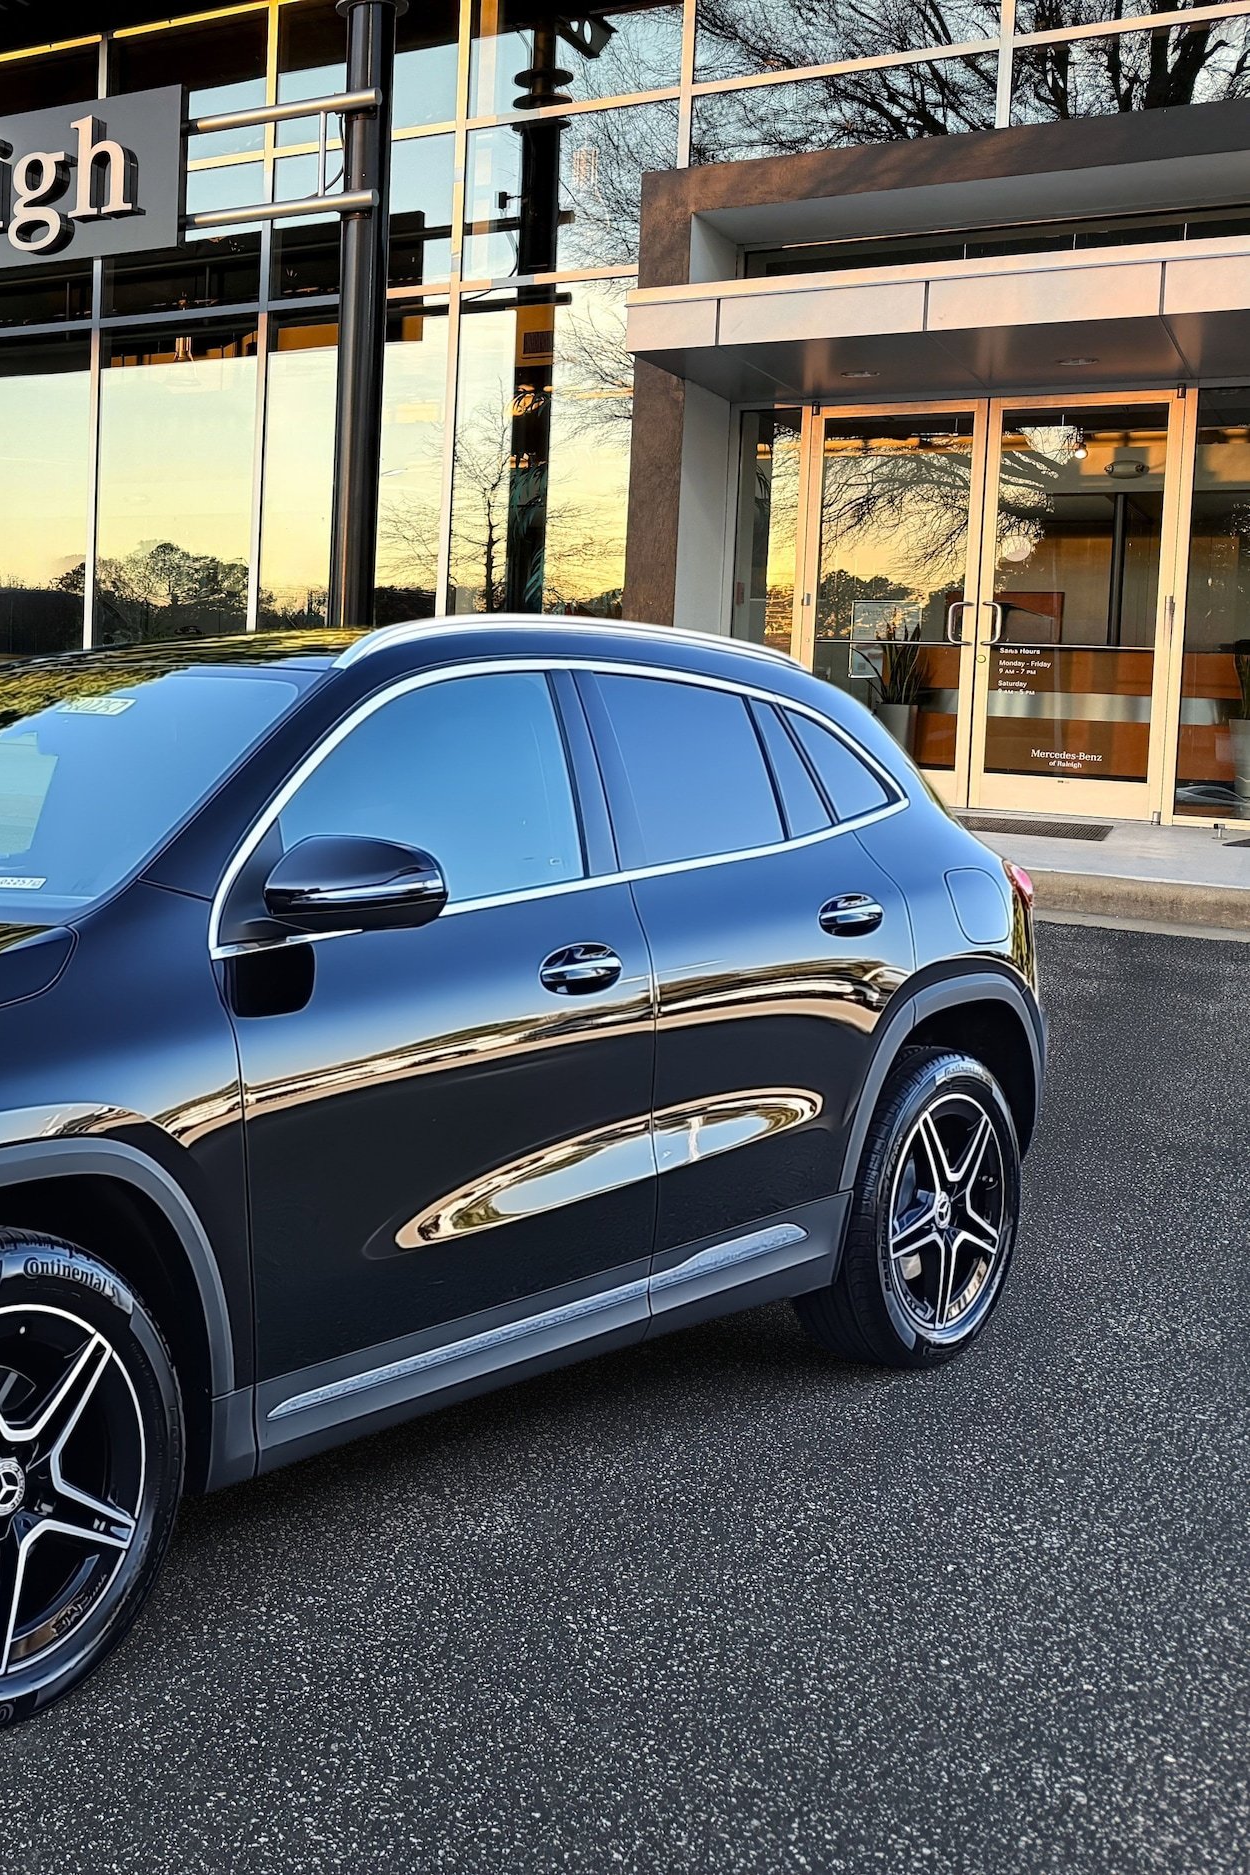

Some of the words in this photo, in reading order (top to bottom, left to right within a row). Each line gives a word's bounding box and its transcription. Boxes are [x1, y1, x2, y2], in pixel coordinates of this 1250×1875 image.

[999, 660, 1026, 668] Monday
[998, 680, 1028, 688] Saturday
[62, 699, 129, 714] 02257
[1031, 749, 1103, 762] Mercedes-Benz
[1057, 760, 1083, 769] Raleigh
[22, 1256, 107, 1295] Continental
